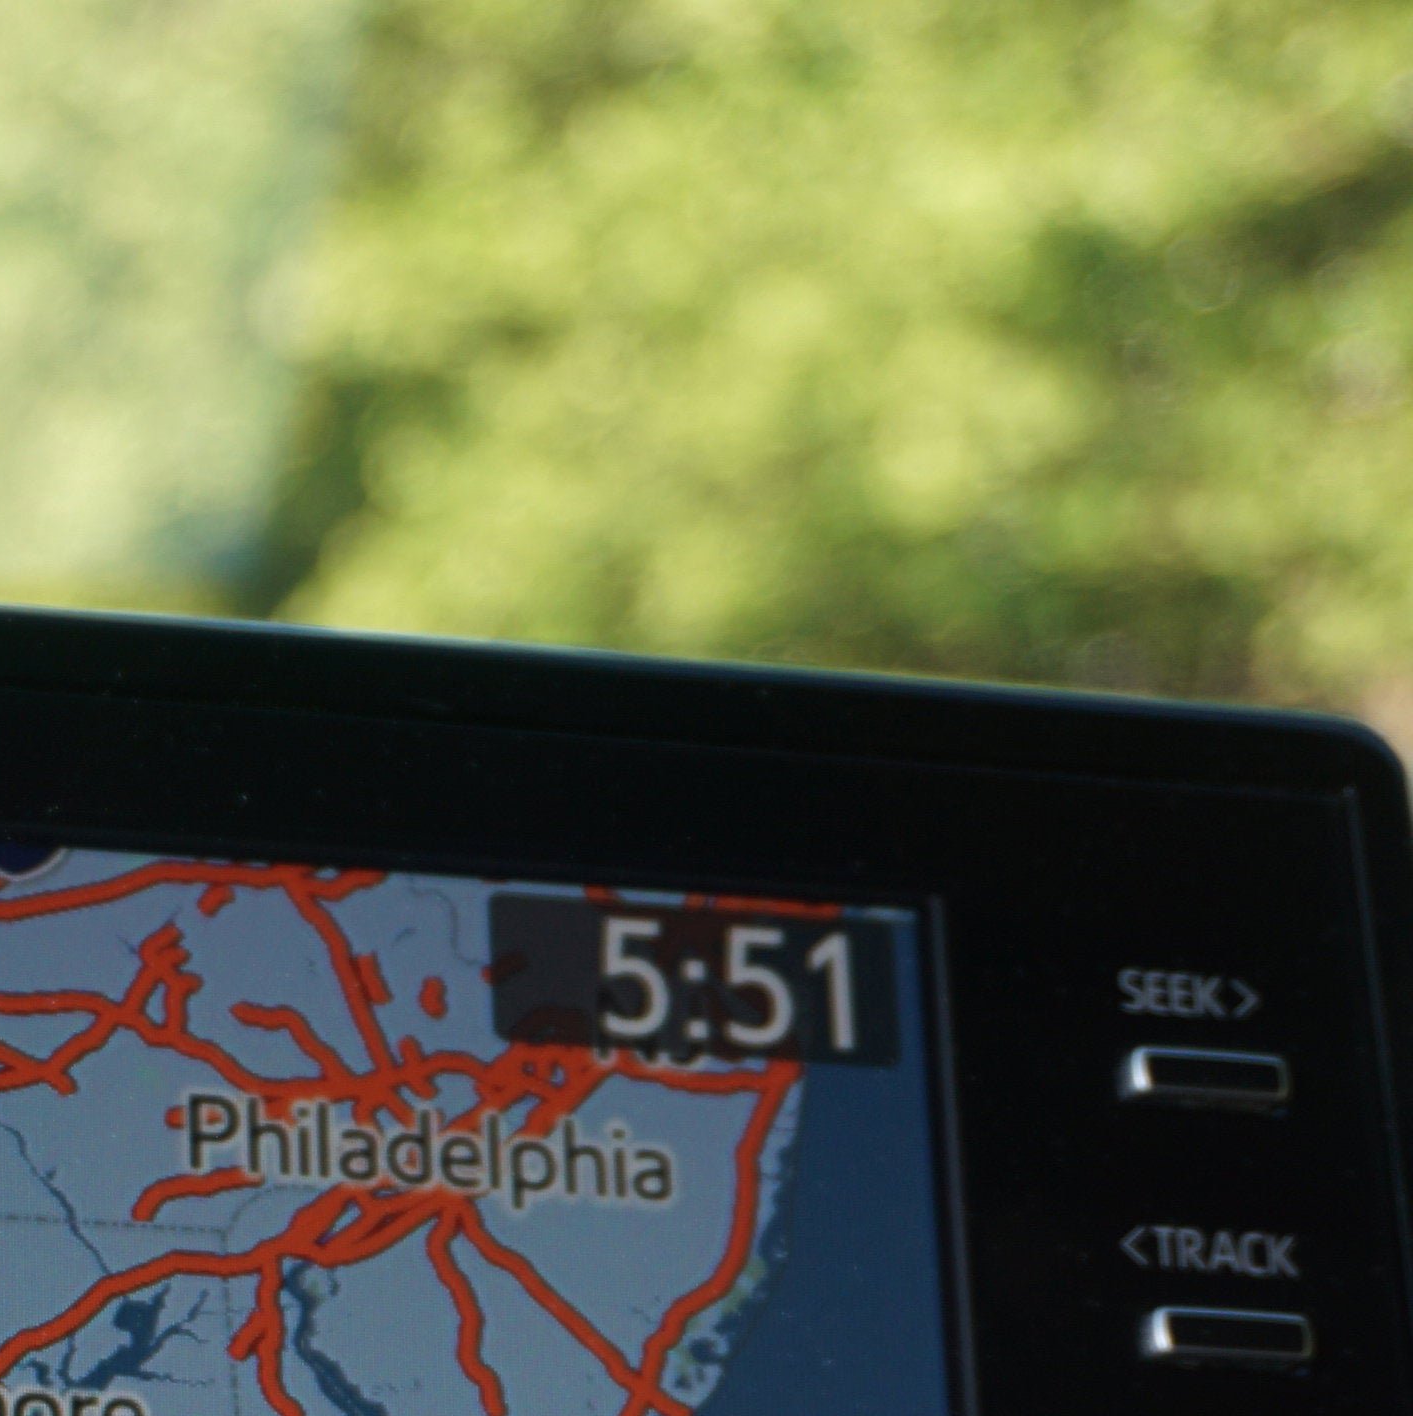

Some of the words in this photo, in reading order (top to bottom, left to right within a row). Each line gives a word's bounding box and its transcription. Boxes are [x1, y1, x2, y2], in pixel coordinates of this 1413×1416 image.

[599, 918, 857, 1050] 5:51
[1118, 968, 1226, 1019] SEEK
[187, 1096, 671, 1208] Philadelphia
[1154, 1226, 1299, 1278] TRACK
